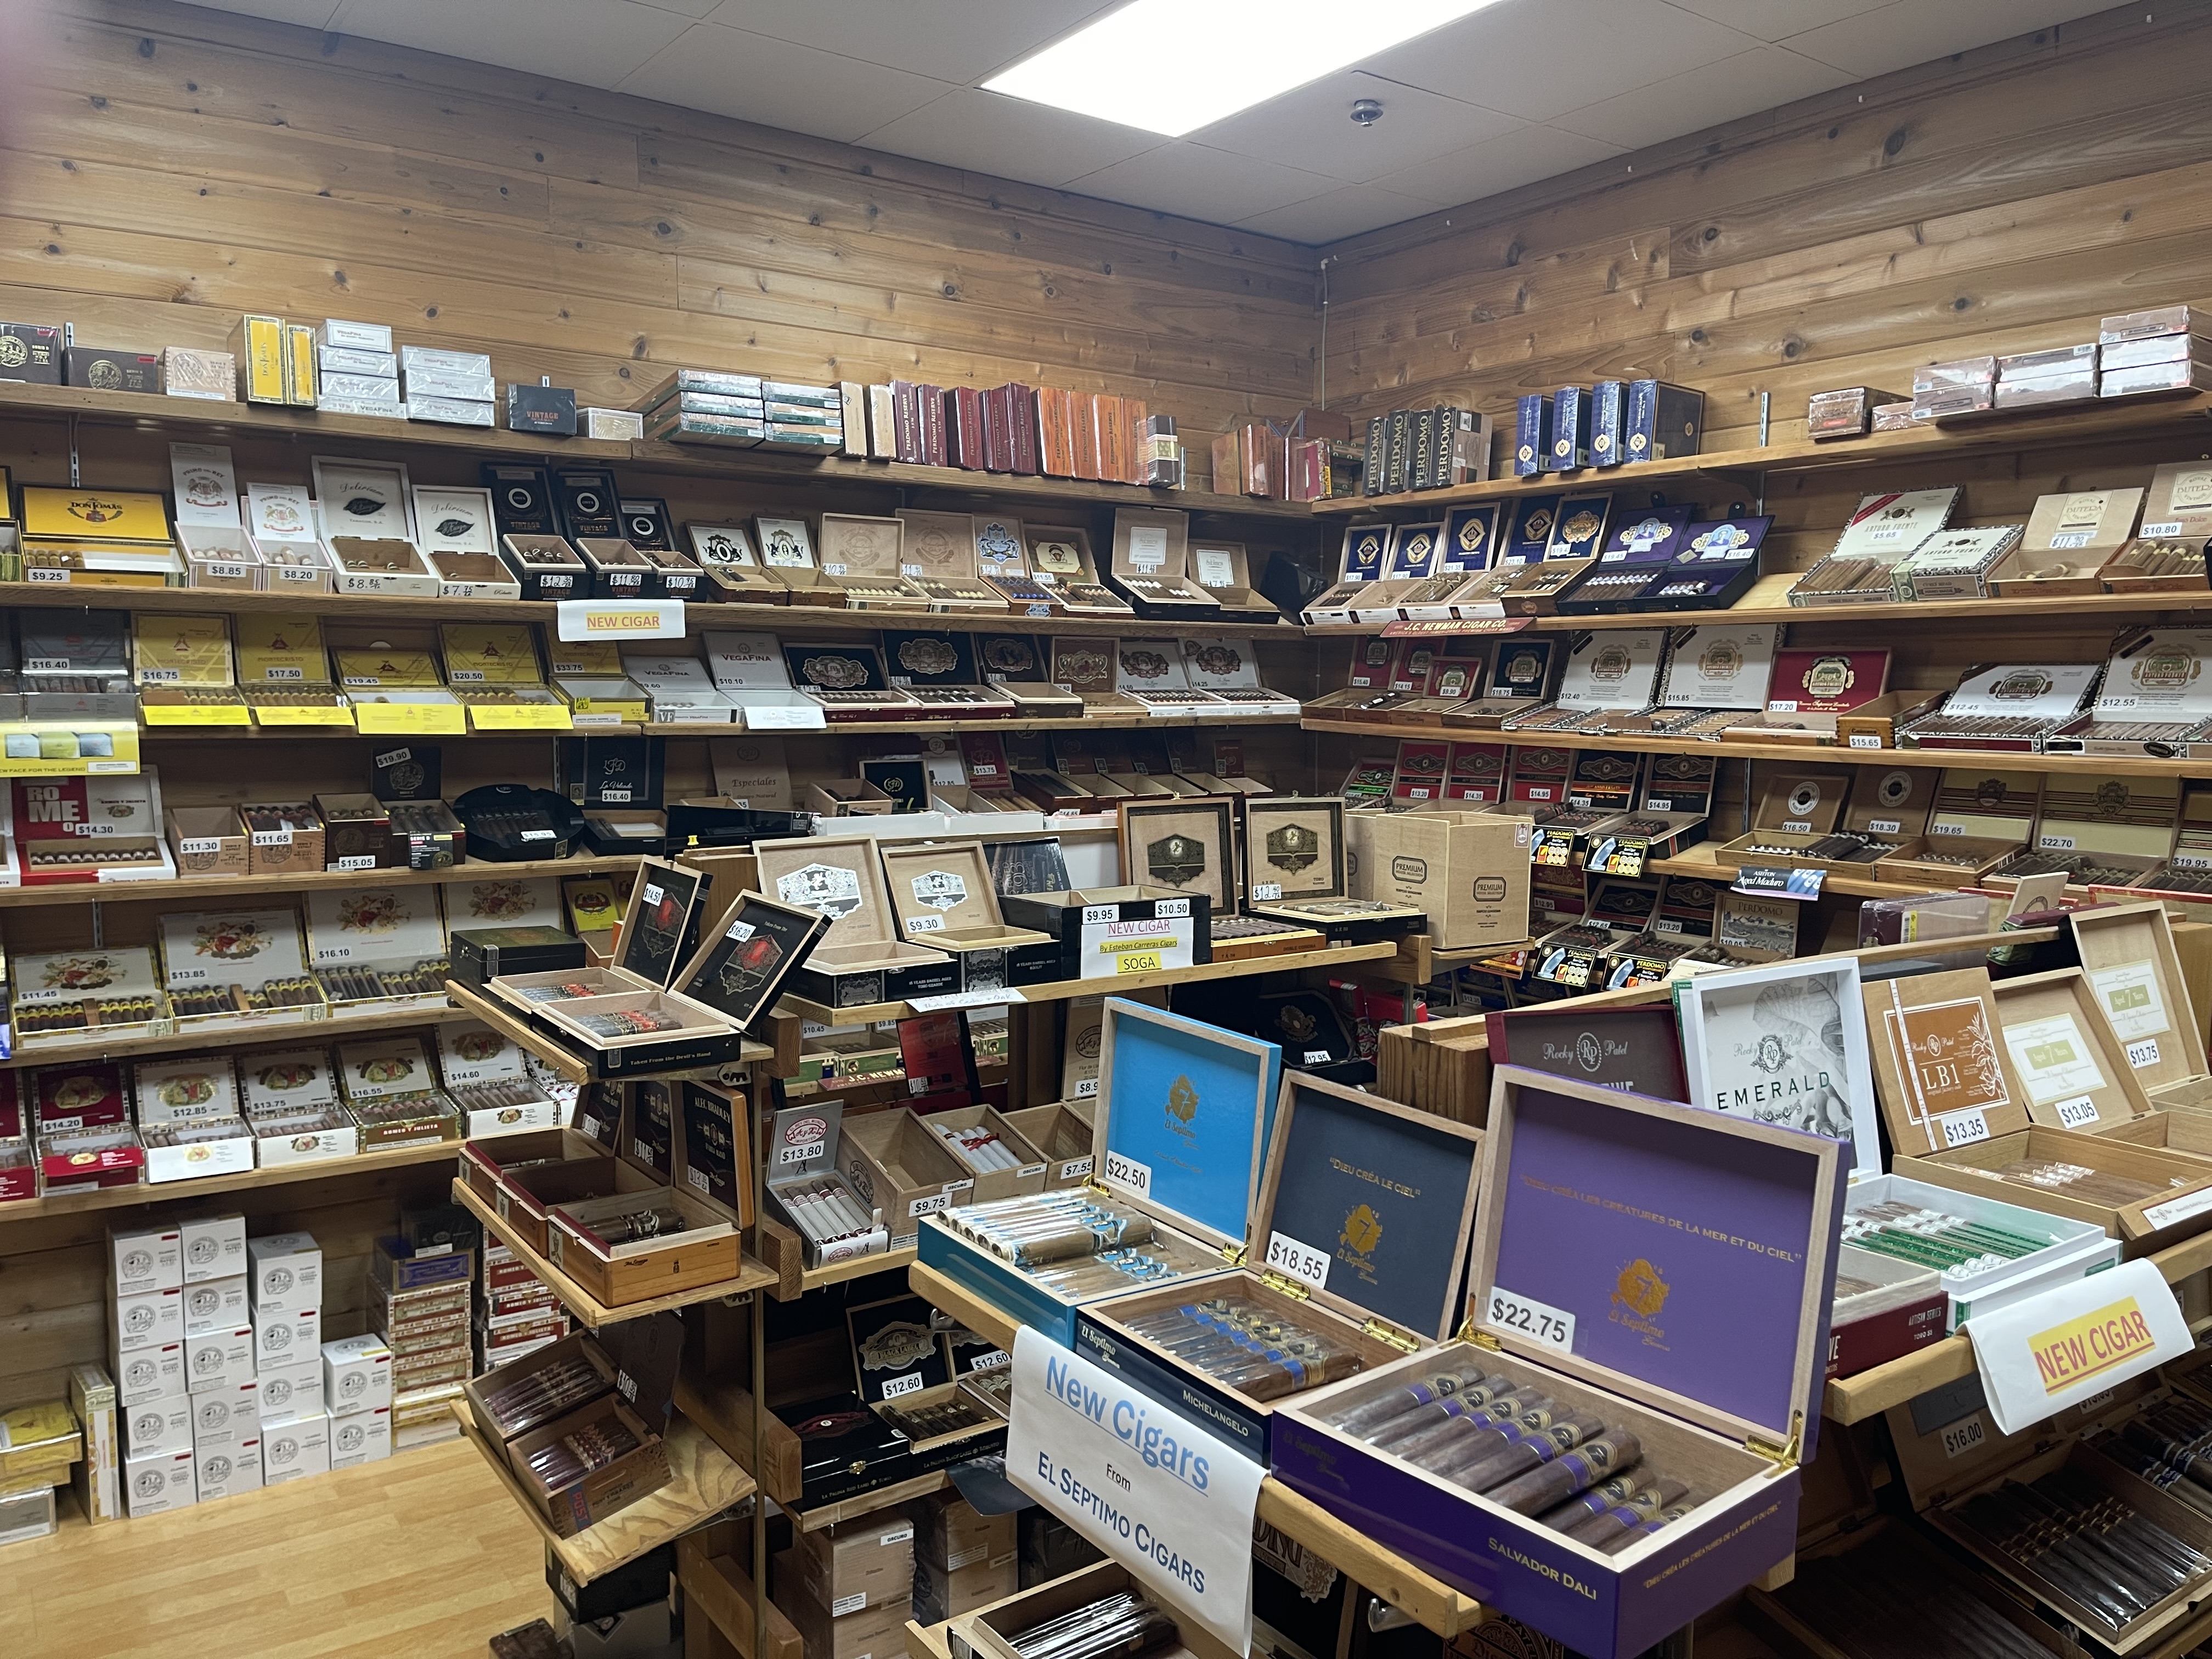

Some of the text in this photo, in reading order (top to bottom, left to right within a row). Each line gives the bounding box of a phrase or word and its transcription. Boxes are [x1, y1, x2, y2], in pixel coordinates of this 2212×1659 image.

[1390, 415, 1404, 486] PERDOMO
[1415, 415, 1429, 483] PERDOMO
[1438, 411, 1451, 481] PERDOMO
[1368, 422, 1380, 489] PERDOMO
[1864, 521, 1918, 533] ARTURO FUENTE
[2143, 526, 2177, 535] $10.80
[32, 572, 63, 580] $9.25
[212, 566, 241, 575] $8.85
[284, 570, 312, 579] $8.20
[587, 616, 660, 628] NEW CIGAR
[1404, 619, 1506, 631] J.C. NEWMAN CIGAR CO.
[268, 670, 300, 678] $17.50
[2102, 699, 2135, 707] $12.55
[659, 710, 674, 722] VF
[1852, 738, 1878, 747] $15.65
[377, 751, 407, 766] $19.90
[732, 778, 776, 787] Especiales
[27, 787, 59, 801] RO
[29, 800, 80, 822] ME
[1649, 802, 1670, 810] $14.95
[1784, 823, 1808, 832] $16.50
[1871, 823, 1896, 832] $18.30
[1933, 825, 1962, 834] $19.65
[256, 835, 289, 844] $11.65
[2042, 838, 2072, 848] $22.70
[183, 842, 218, 851] $11.30
[341, 859, 373, 867] $15.05
[1396, 862, 1423, 873] PREMIUM
[2172, 857, 2208, 868] $19.95
[1737, 876, 1784, 887] Aged Maduro
[644, 889, 660, 902] $14.50
[1158, 903, 1187, 915] $10.50
[1739, 901, 1783, 916] PERDOMO
[1087, 909, 1113, 922] $9.95
[910, 919, 938, 931] $9.30
[1108, 919, 1170, 934] NEW CIGAR
[1659, 923, 1679, 931] $13.20
[729, 925, 750, 939] $16.20
[1109, 943, 1133, 951] Esteban
[1160, 939, 1177, 948] Cigars
[319, 948, 349, 958] $16.10
[1124, 956, 1156, 970] SOGA
[1637, 961, 1665, 969] PERDOMO
[172, 969, 205, 979] $13.85
[22, 990, 56, 1000] $11.45
[1543, 1039, 1628, 1063] Rocky Patel
[1734, 1034, 1804, 1057] Rocky Patel
[1304, 1052, 1329, 1063] $12.95
[2130, 1045, 2158, 1065] $13.75
[452, 1071, 479, 1080] $14.60
[848, 1074, 871, 1082] J.C.
[1921, 1063, 1960, 1090] LB1
[352, 1087, 382, 1097] $16.55
[1717, 1071, 1830, 1110] EMERALD
[253, 1100, 286, 1110] $13.75
[695, 1097, 731, 1124] ALEC BRADLEY
[173, 1107, 207, 1117] $12.85
[2061, 1102, 2095, 1125] $13.05
[45, 1119, 80, 1130] $14.20
[1172, 1122, 1196, 1138] Septimo
[1946, 1118, 1984, 1143] $13.35
[782, 1146, 821, 1162] $13.80
[1108, 1157, 1146, 1188] $22.50
[1356, 1169, 1392, 1190] CRÉA LE
[915, 1198, 946, 1213] $9.75
[1668, 1218, 1764, 1253] DE LA MER ET DU
[1271, 1240, 1323, 1280] $18.55
[1336, 1248, 1375, 1273] El Septimo
[1493, 1296, 1566, 1342] $22.75
[1621, 1314, 1664, 1338] Septimo
[1081, 1325, 1116, 1356] El Septimo
[2034, 1310, 2152, 1383] NEW CIGAR
[878, 1342, 921, 1359] BLACK LABEL
[975, 1352, 1008, 1369] $12.60
[885, 1378, 921, 1396] $12.60
[1183, 1390, 1249, 1437] MICHELANGELO
[1046, 1355, 1209, 1491] New Cigars
[1946, 1421, 1983, 1452] $16.00
[1107, 1463, 1131, 1492] From
[1039, 1451, 1205, 1594] EL SEPTIMO CIGARS
[888, 1533, 907, 1542] OSCURO
[1488, 1537, 1597, 1600] SALVADOR DALI
